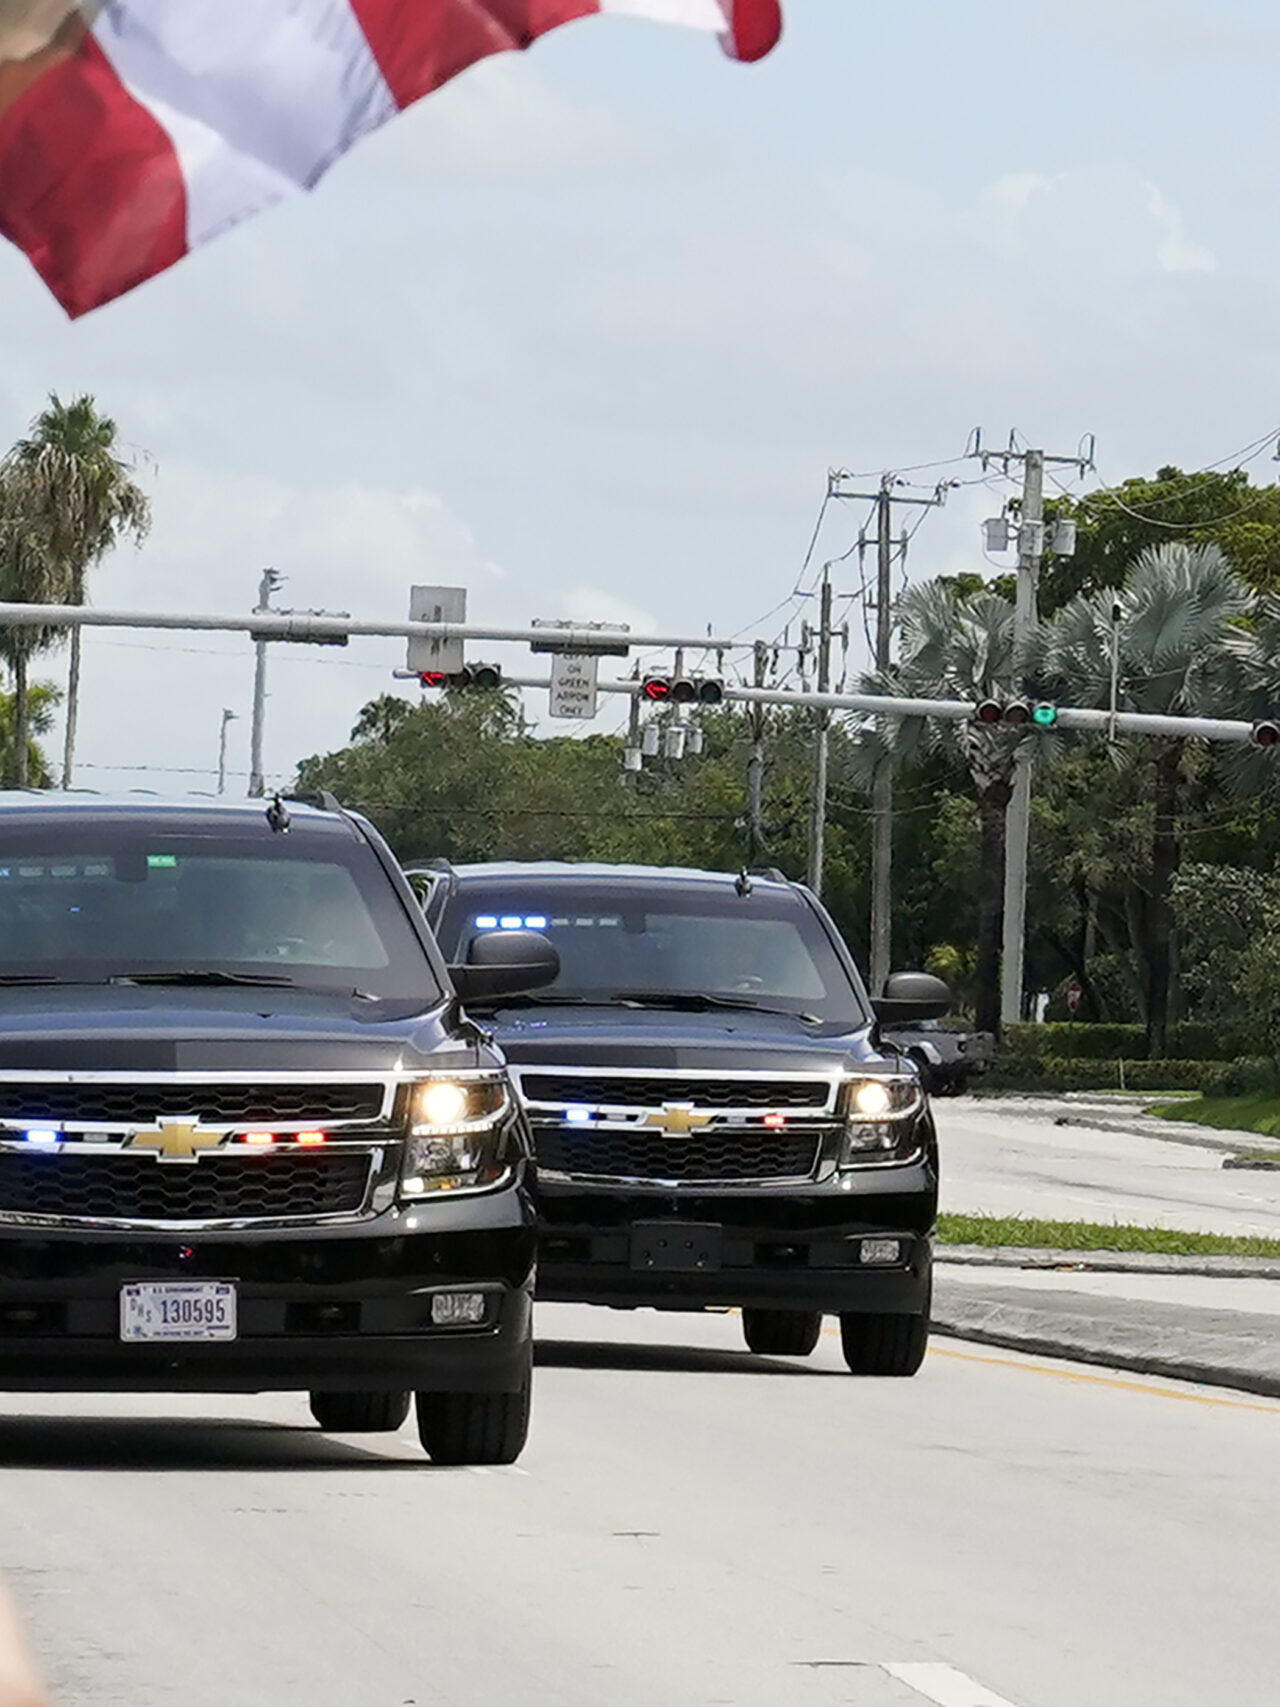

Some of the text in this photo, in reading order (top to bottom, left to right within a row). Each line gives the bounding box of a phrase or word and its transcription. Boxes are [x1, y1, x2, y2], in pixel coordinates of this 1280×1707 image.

[567, 664, 582, 673] ON
[558, 677, 589, 687] GREEN
[555, 690, 589, 702] ARROW
[559, 704, 582, 715] ONLY
[160, 1299, 225, 1323] 130595
